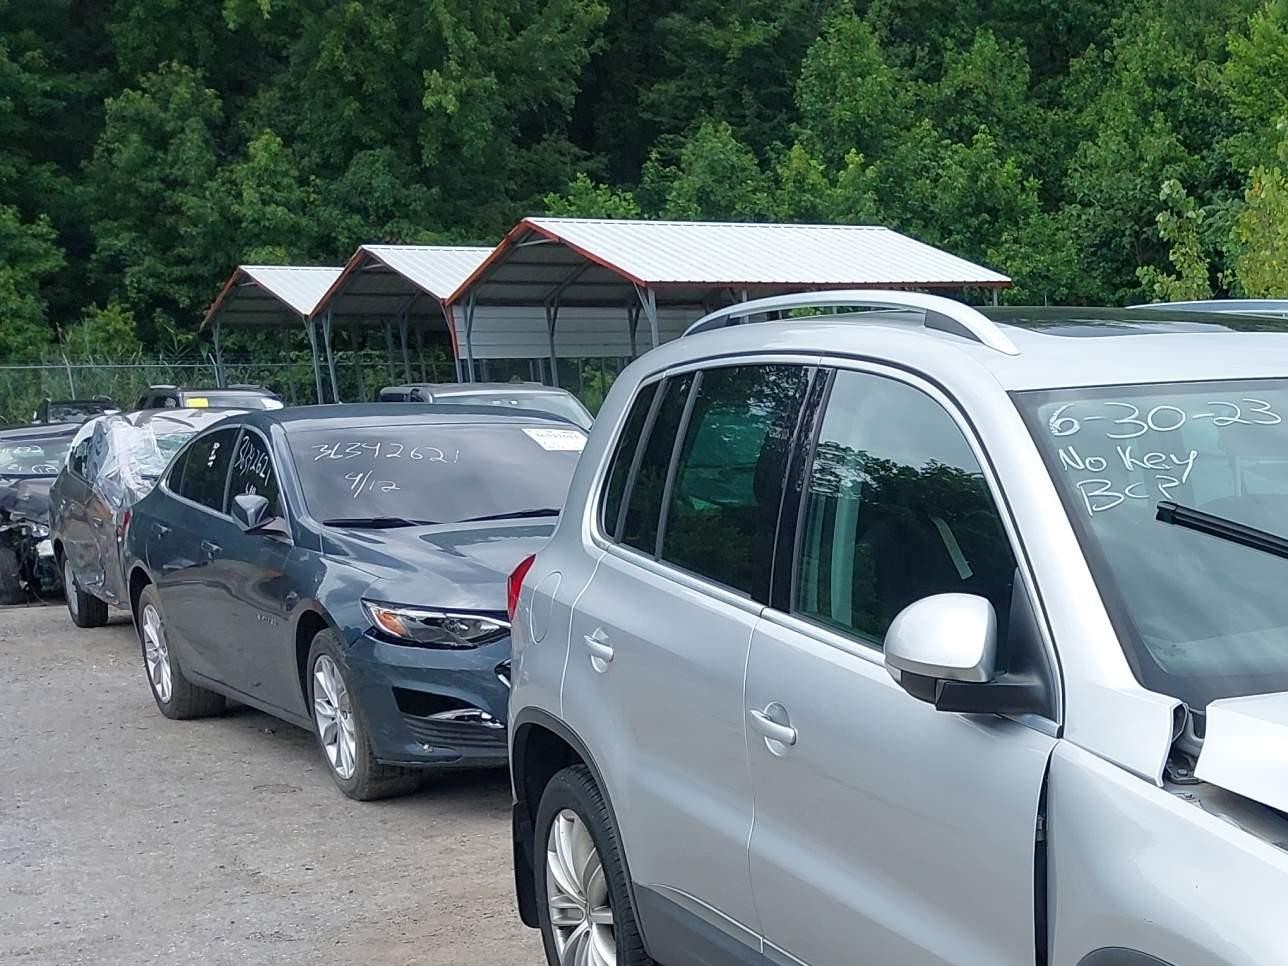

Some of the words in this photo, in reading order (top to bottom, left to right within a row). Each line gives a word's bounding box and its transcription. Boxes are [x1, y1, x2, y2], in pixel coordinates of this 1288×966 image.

[1048, 398, 1282, 439] 6-30-23
[1058, 446, 1107, 472] No
[1117, 446, 1197, 482] Key
